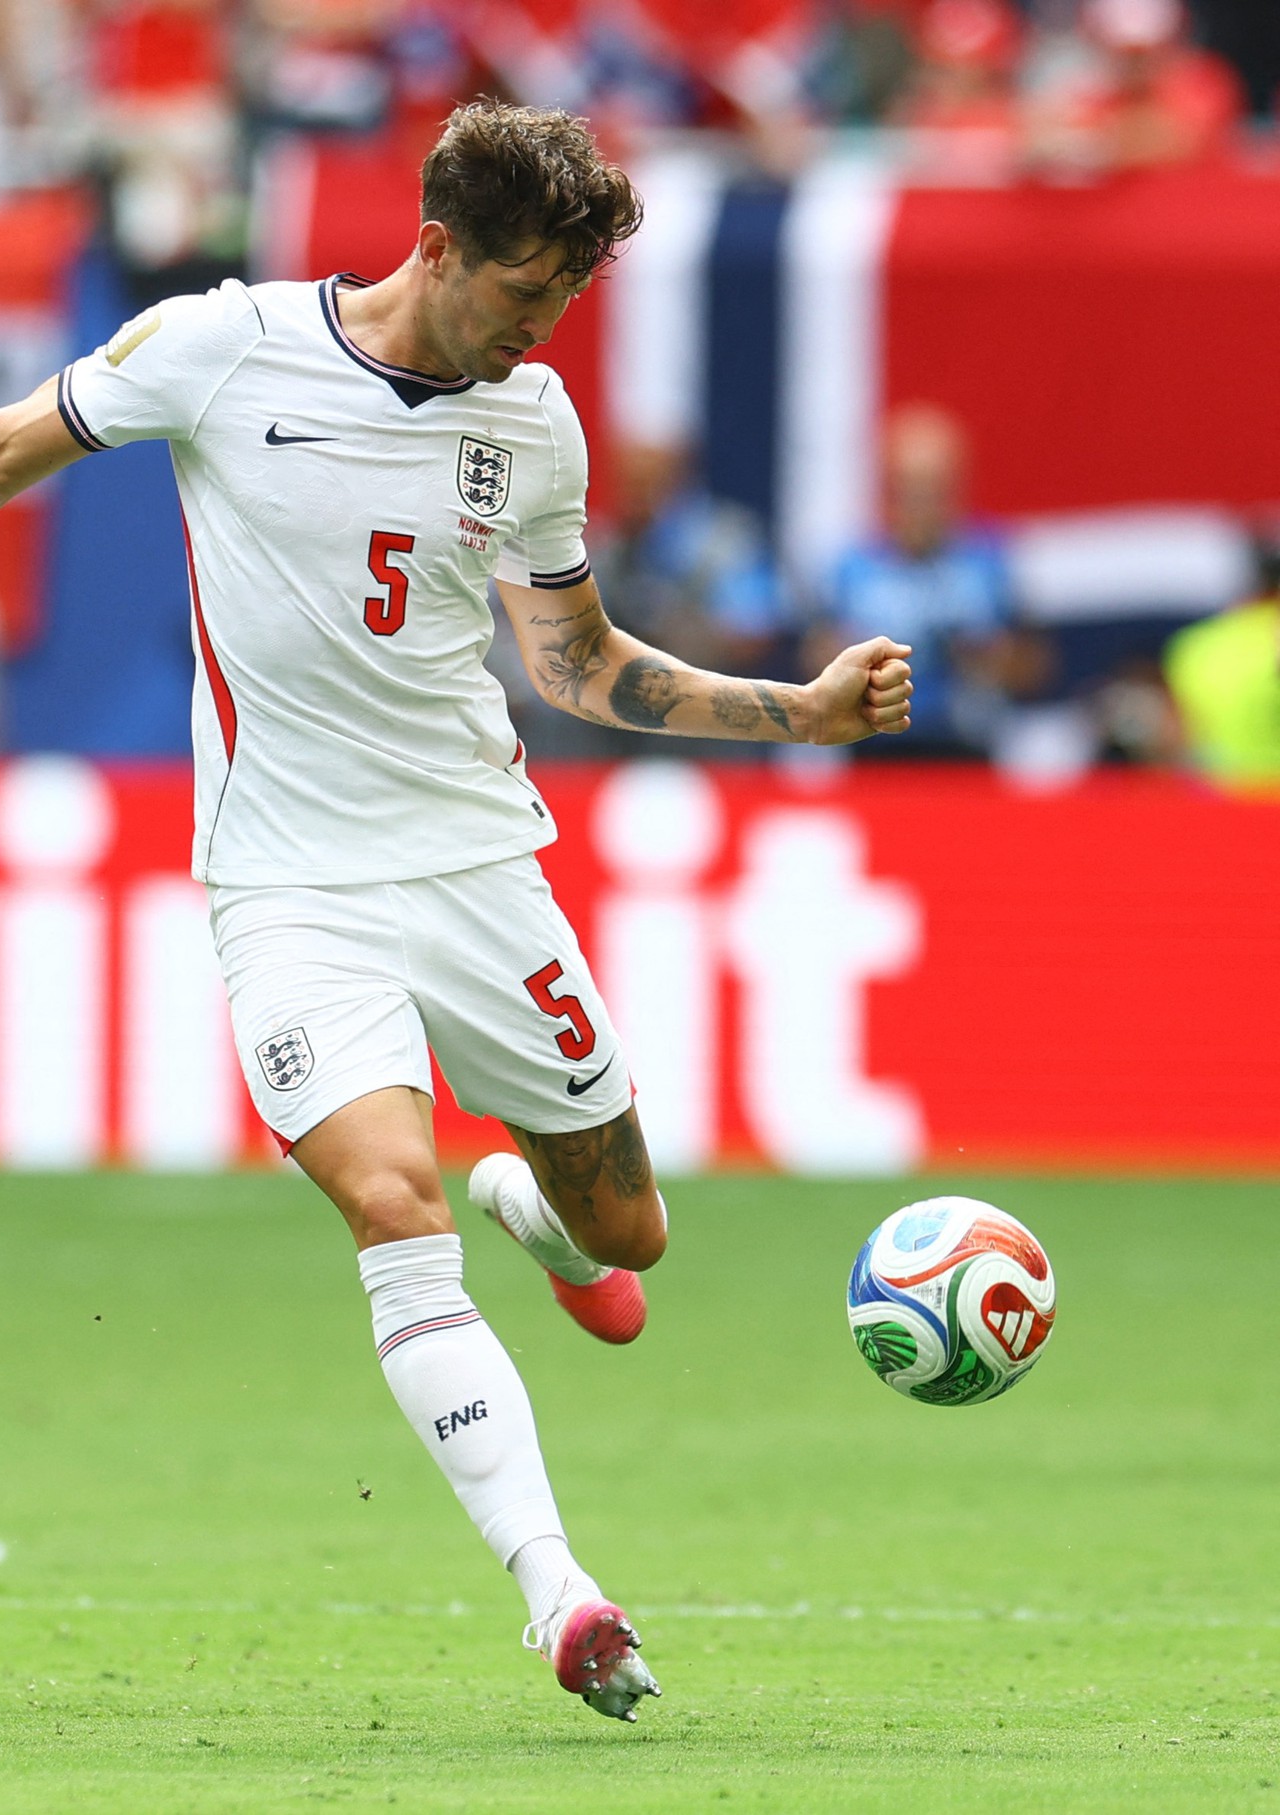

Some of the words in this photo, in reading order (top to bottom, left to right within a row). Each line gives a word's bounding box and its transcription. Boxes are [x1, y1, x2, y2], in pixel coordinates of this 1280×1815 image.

[459, 517, 497, 537] NORWAY
[363, 529, 415, 636] 5
[523, 958, 596, 1062] 5
[588, 758, 928, 1174] it
[434, 1400, 488, 1442] ENG
